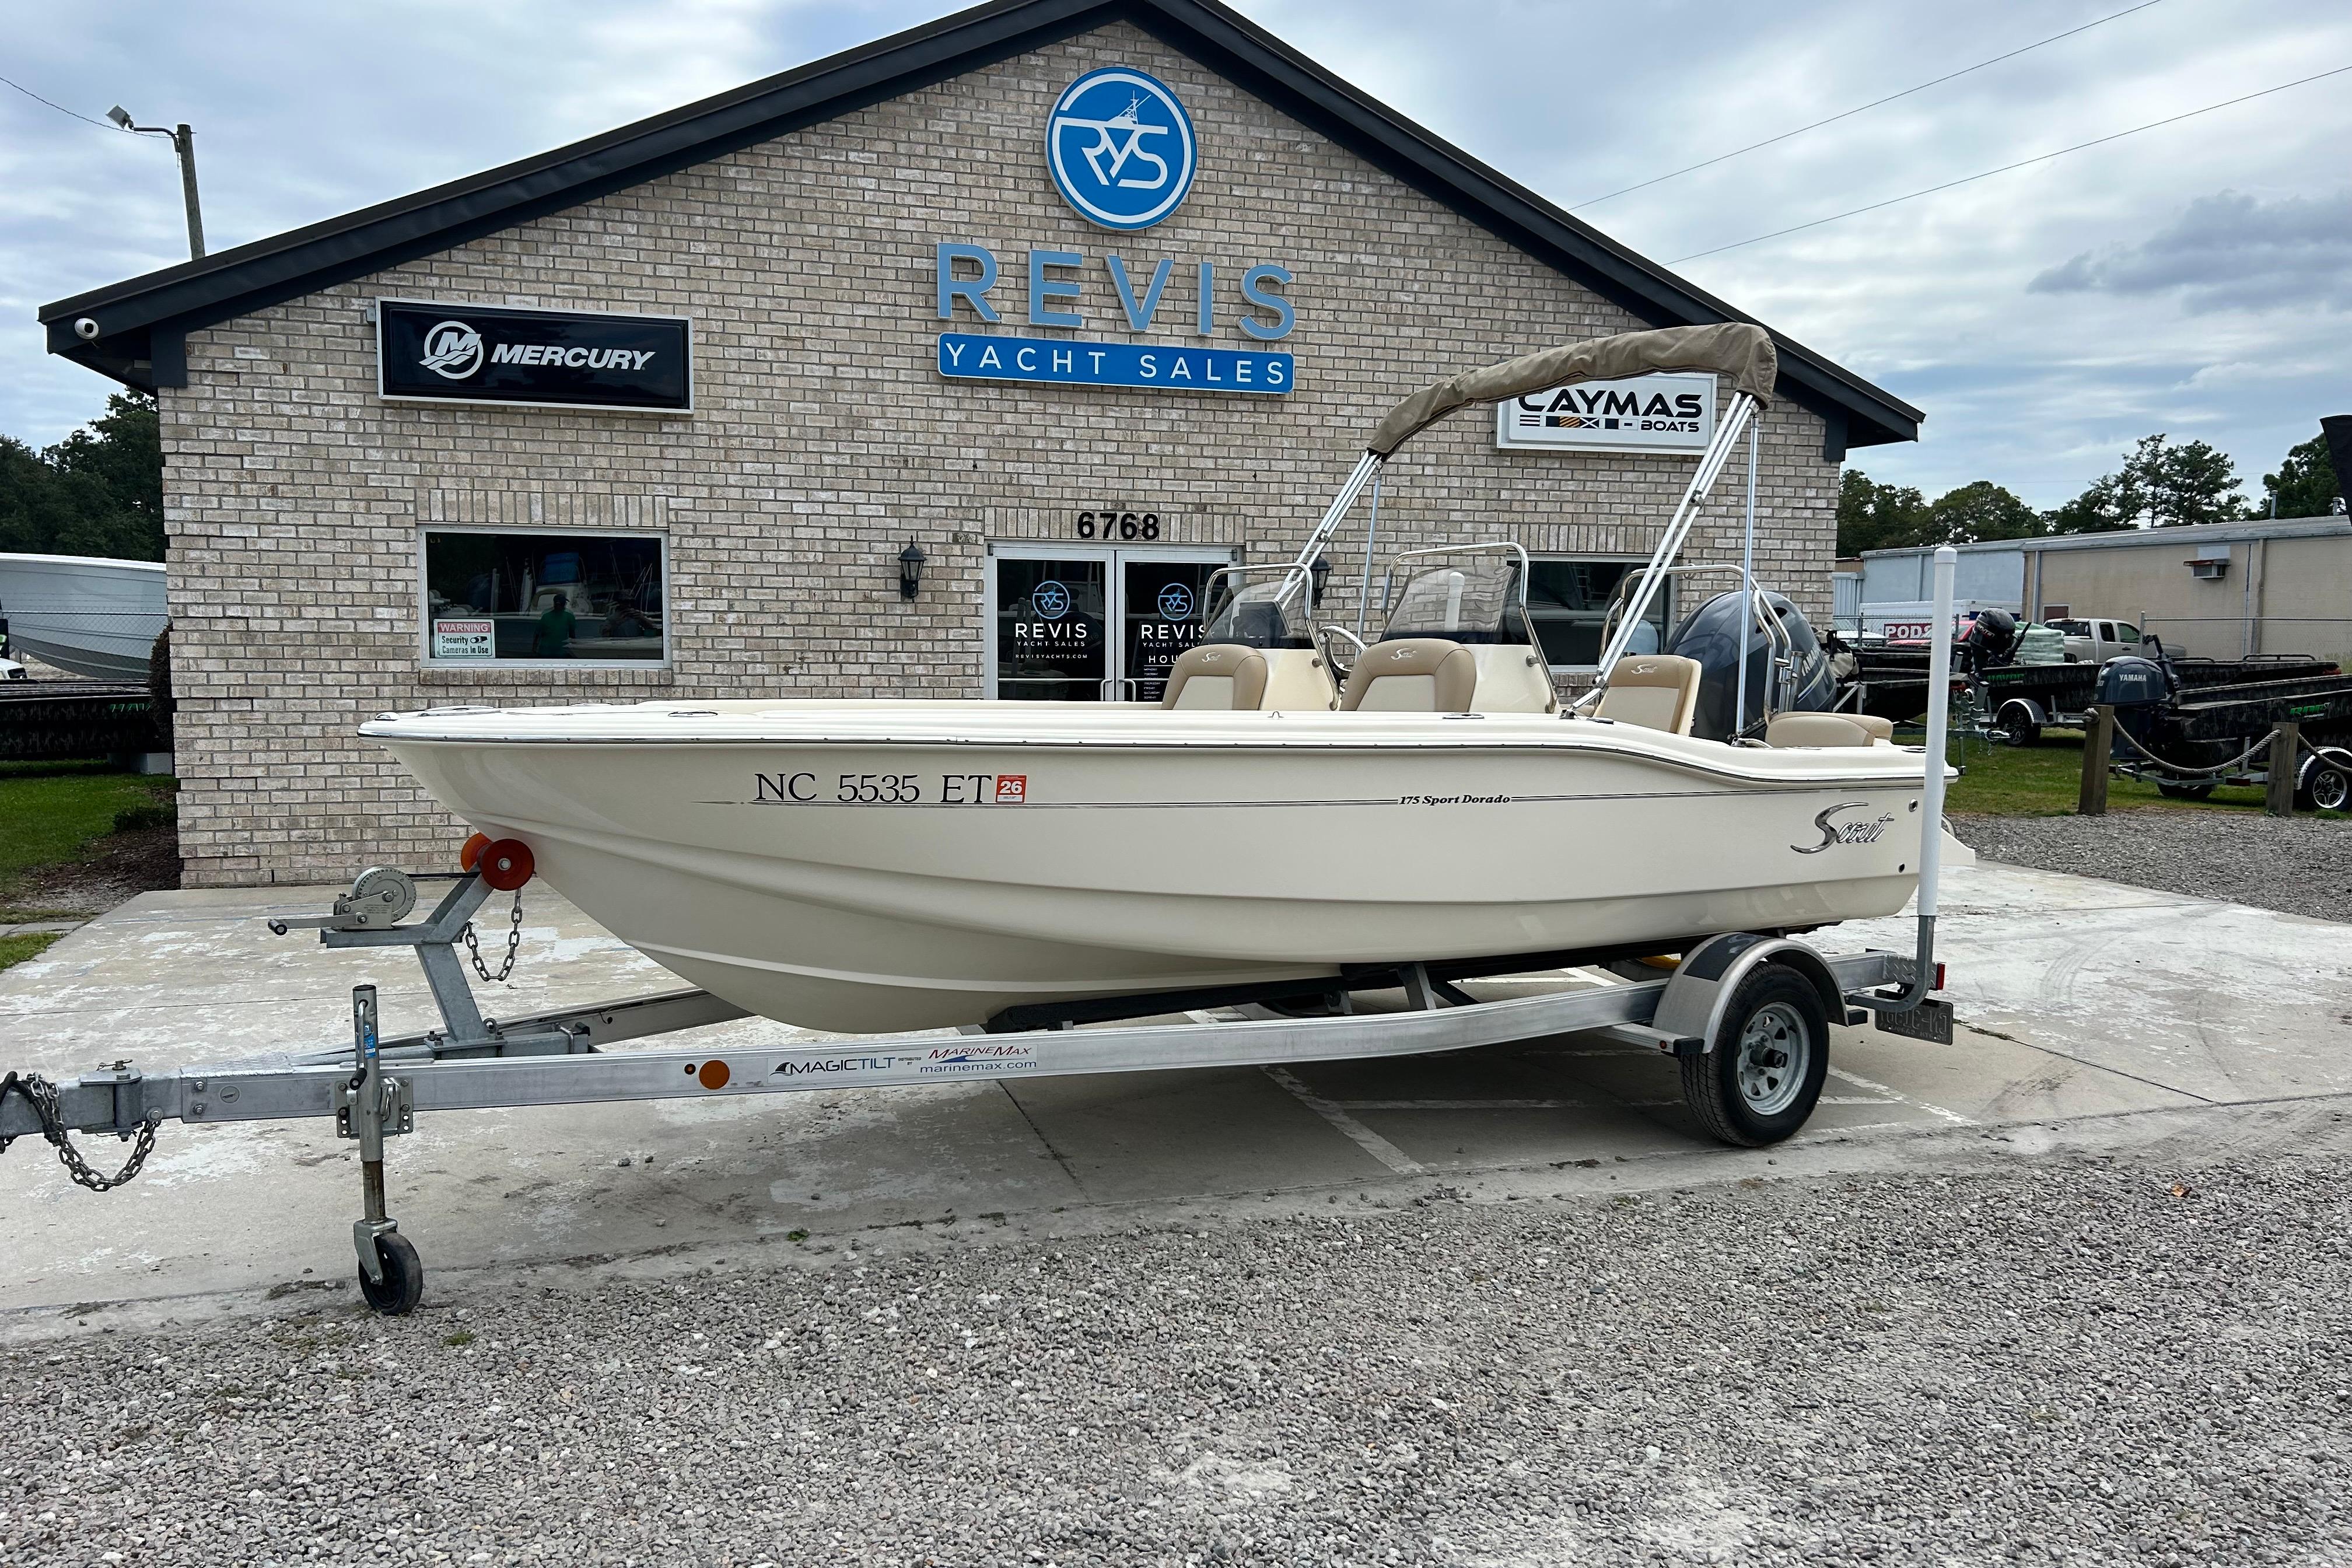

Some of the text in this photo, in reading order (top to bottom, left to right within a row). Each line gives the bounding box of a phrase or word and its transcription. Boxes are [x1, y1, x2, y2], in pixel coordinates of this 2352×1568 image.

[936, 242, 1296, 340] REVIS
[490, 343, 656, 370] MERCURY
[945, 342, 1284, 384] YACHT SALES
[1518, 388, 1702, 418] CAYMAS
[1641, 419, 1700, 432] BOATS
[1077, 512, 1159, 540] 6768
[440, 623, 488, 632] WARNING
[1015, 623, 1087, 638] REVIS
[442, 635, 468, 645] Security
[442, 646, 489, 654] Cameras In Use
[1149, 655, 1178, 664] HOU
[2119, 674, 2147, 682] YAMAHA
[754, 773, 992, 804] NC 5535 ET
[999, 780, 1023, 794] 26
[1399, 794, 1510, 806] 175 Sport Dorado
[1790, 802, 1895, 854] Scout
[790, 1056, 895, 1074] MAGICTILT
[920, 1060, 1037, 1073] marinemax.com
